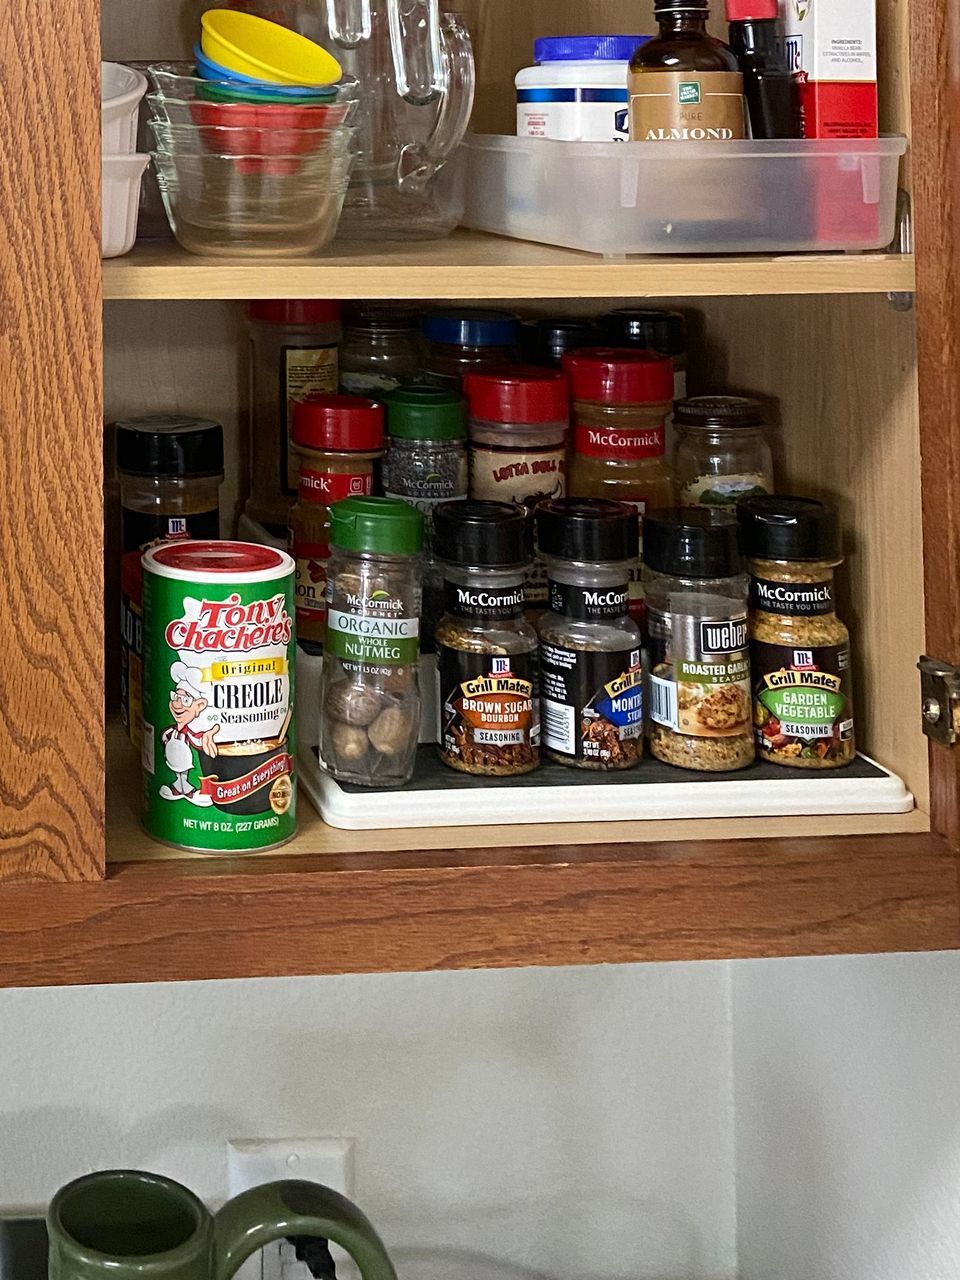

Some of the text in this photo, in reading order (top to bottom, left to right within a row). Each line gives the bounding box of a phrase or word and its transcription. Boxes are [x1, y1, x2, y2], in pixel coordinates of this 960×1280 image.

[680, 112, 704, 121] PURE
[645, 128, 733, 140] ALMOND
[588, 430, 661, 447] McCormick
[492, 459, 557, 482] LOTTA BULL
[402, 478, 454, 490] McCormick
[756, 582, 832, 602] McCormick
[346, 594, 404, 611] McCormick
[588, 606, 601, 614] THE
[772, 601, 794, 610] TASTE
[200, 594, 285, 630] Tony
[351, 608, 398, 618] GOURMET
[166, 612, 292, 650] Chachere's
[338, 615, 408, 636] ORGANIC
[358, 636, 388, 647] WHOLE
[706, 622, 747, 649] weber
[344, 642, 401, 659] NUTMEG
[220, 660, 276, 676] Original
[682, 663, 726, 676] ROASTED
[466, 680, 493, 695] Grill
[497, 680, 530, 694] Mates
[611, 674, 632, 694] Grill
[770, 672, 837, 689] Grill Mates
[213, 678, 283, 710] CREOLE
[782, 692, 828, 706] GARDEN
[462, 698, 533, 714] BROWN SUGAR
[775, 702, 836, 718] VEGETABLE
[220, 709, 280, 725] Seasoning
[480, 713, 520, 724] BOURBON
[479, 731, 520, 742] SEASONING
[786, 724, 829, 736] SEASONING
[216, 756, 286, 799] Great on Everything!
[184, 816, 280, 834] NET WT 8 OZ. (227 GRAMS)
